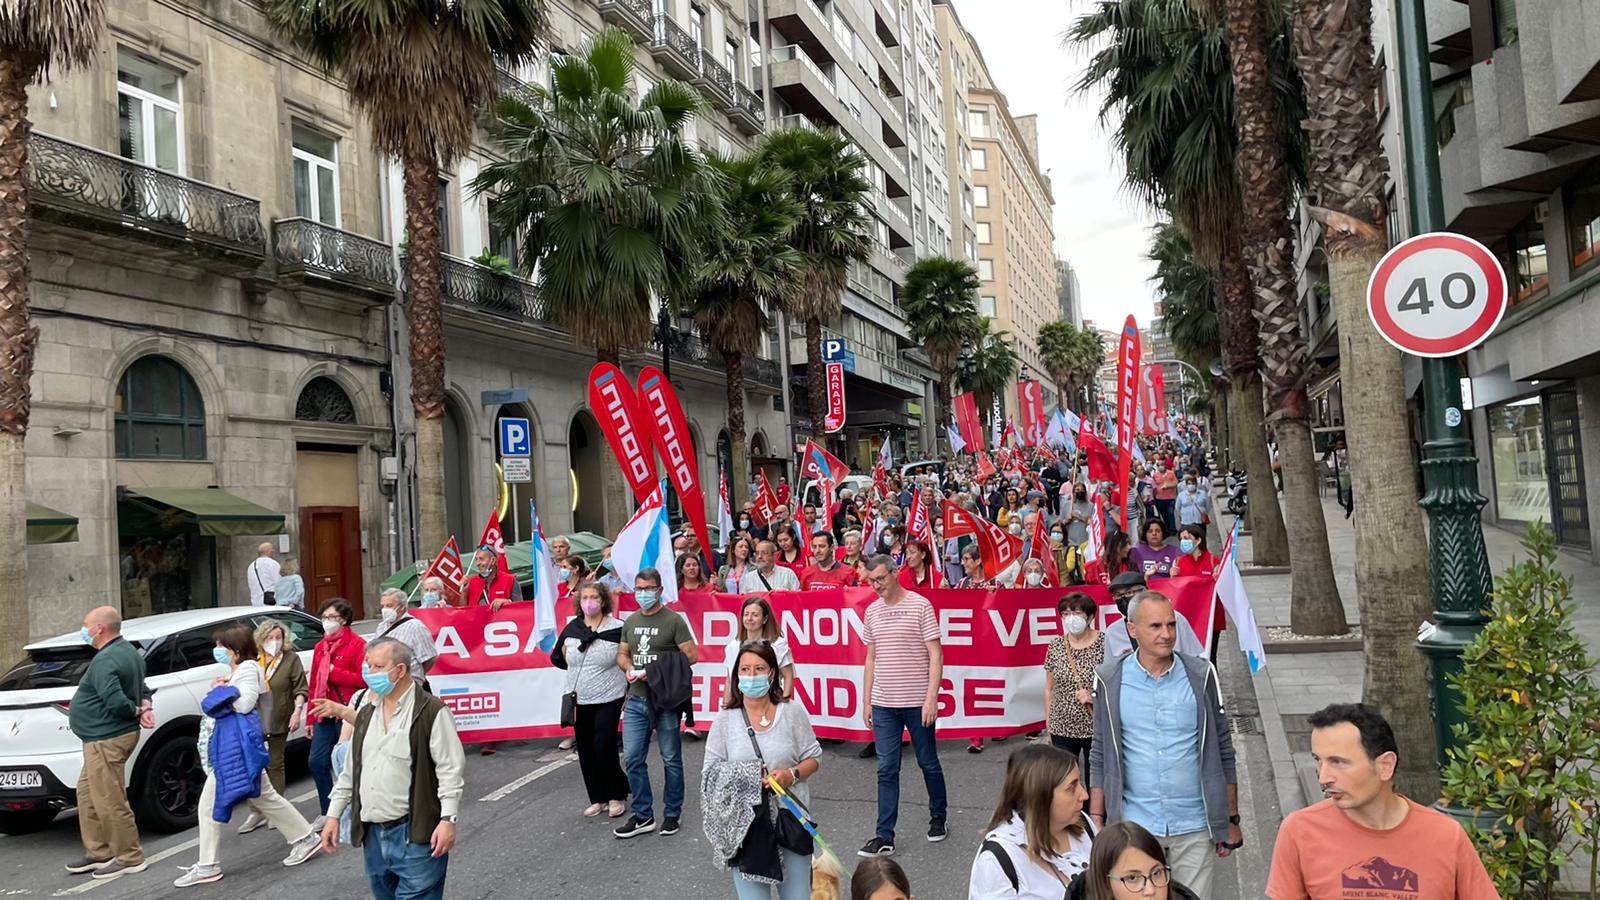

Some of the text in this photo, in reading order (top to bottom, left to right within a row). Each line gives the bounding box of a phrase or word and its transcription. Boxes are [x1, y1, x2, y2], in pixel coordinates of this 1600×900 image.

[1397, 272, 1476, 315] 40
[827, 341, 840, 358] P
[830, 365, 841, 415] GARAJE
[1143, 366, 1165, 432] CIG
[507, 424, 525, 452] P
[602, 383, 649, 483] CCOO
[649, 388, 693, 492] CCOO
[435, 626, 471, 658] A
[780, 608, 868, 646] NON
[939, 608, 973, 646] E
[20, 772, 39, 786] LGK
